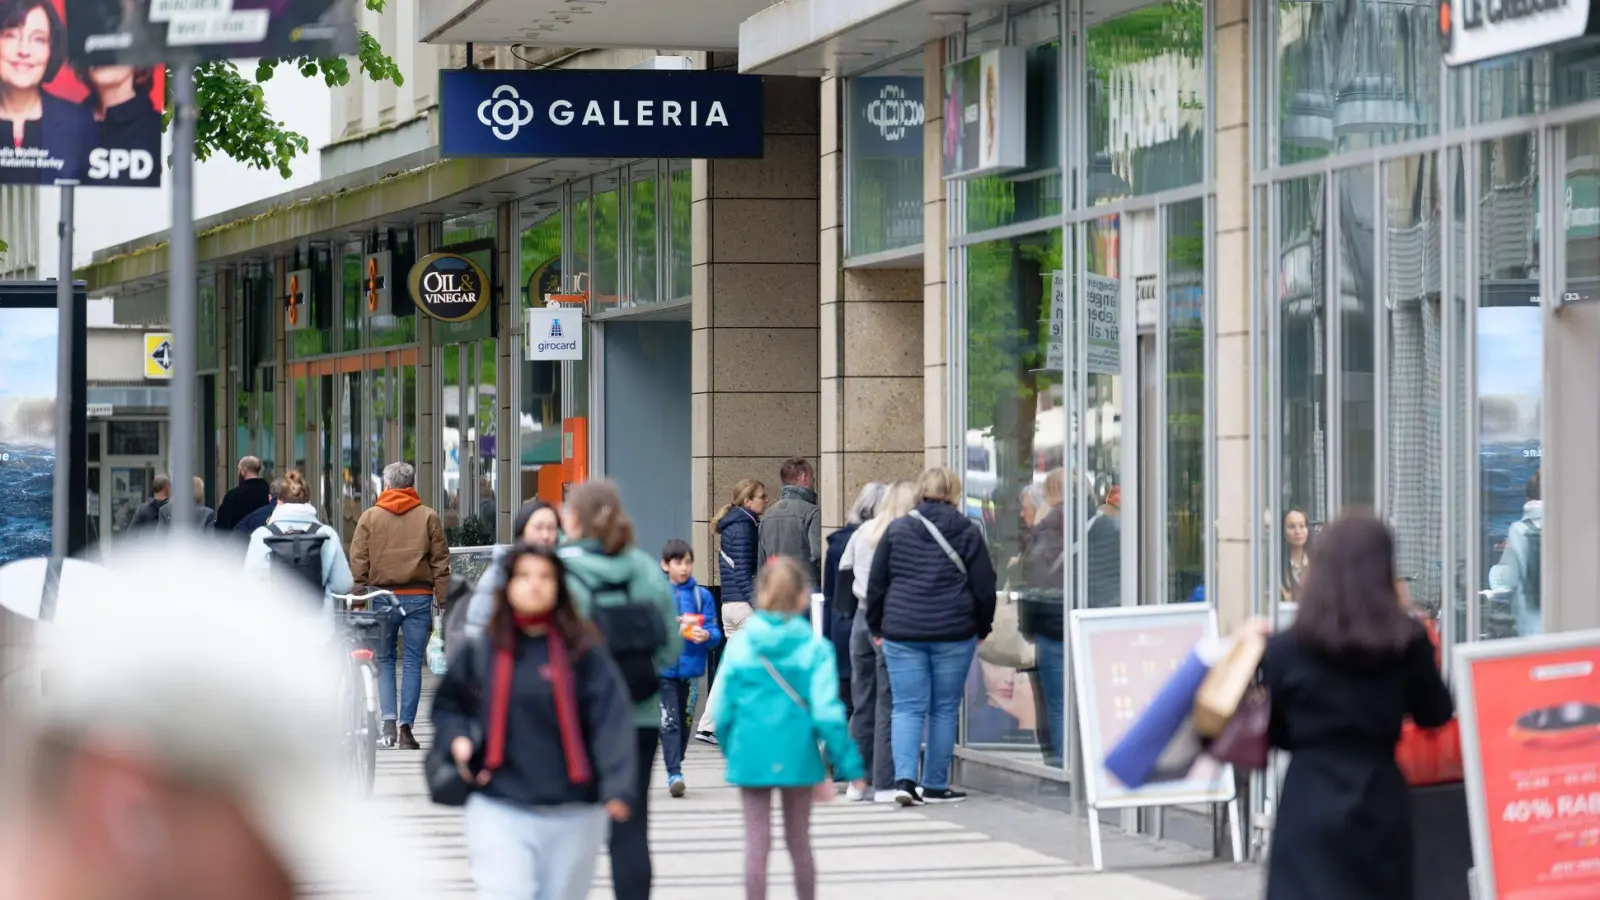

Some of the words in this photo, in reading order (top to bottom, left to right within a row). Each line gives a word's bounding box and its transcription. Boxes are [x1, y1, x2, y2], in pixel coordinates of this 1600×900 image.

[548, 99, 729, 126] GALERIA
[87, 147, 154, 180] SPD
[424, 271, 461, 293] OIL
[460, 274, 475, 291] &
[424, 293, 476, 303] VINEGAR
[538, 340, 576, 352] girocard
[1502, 798, 1555, 822] 40%
